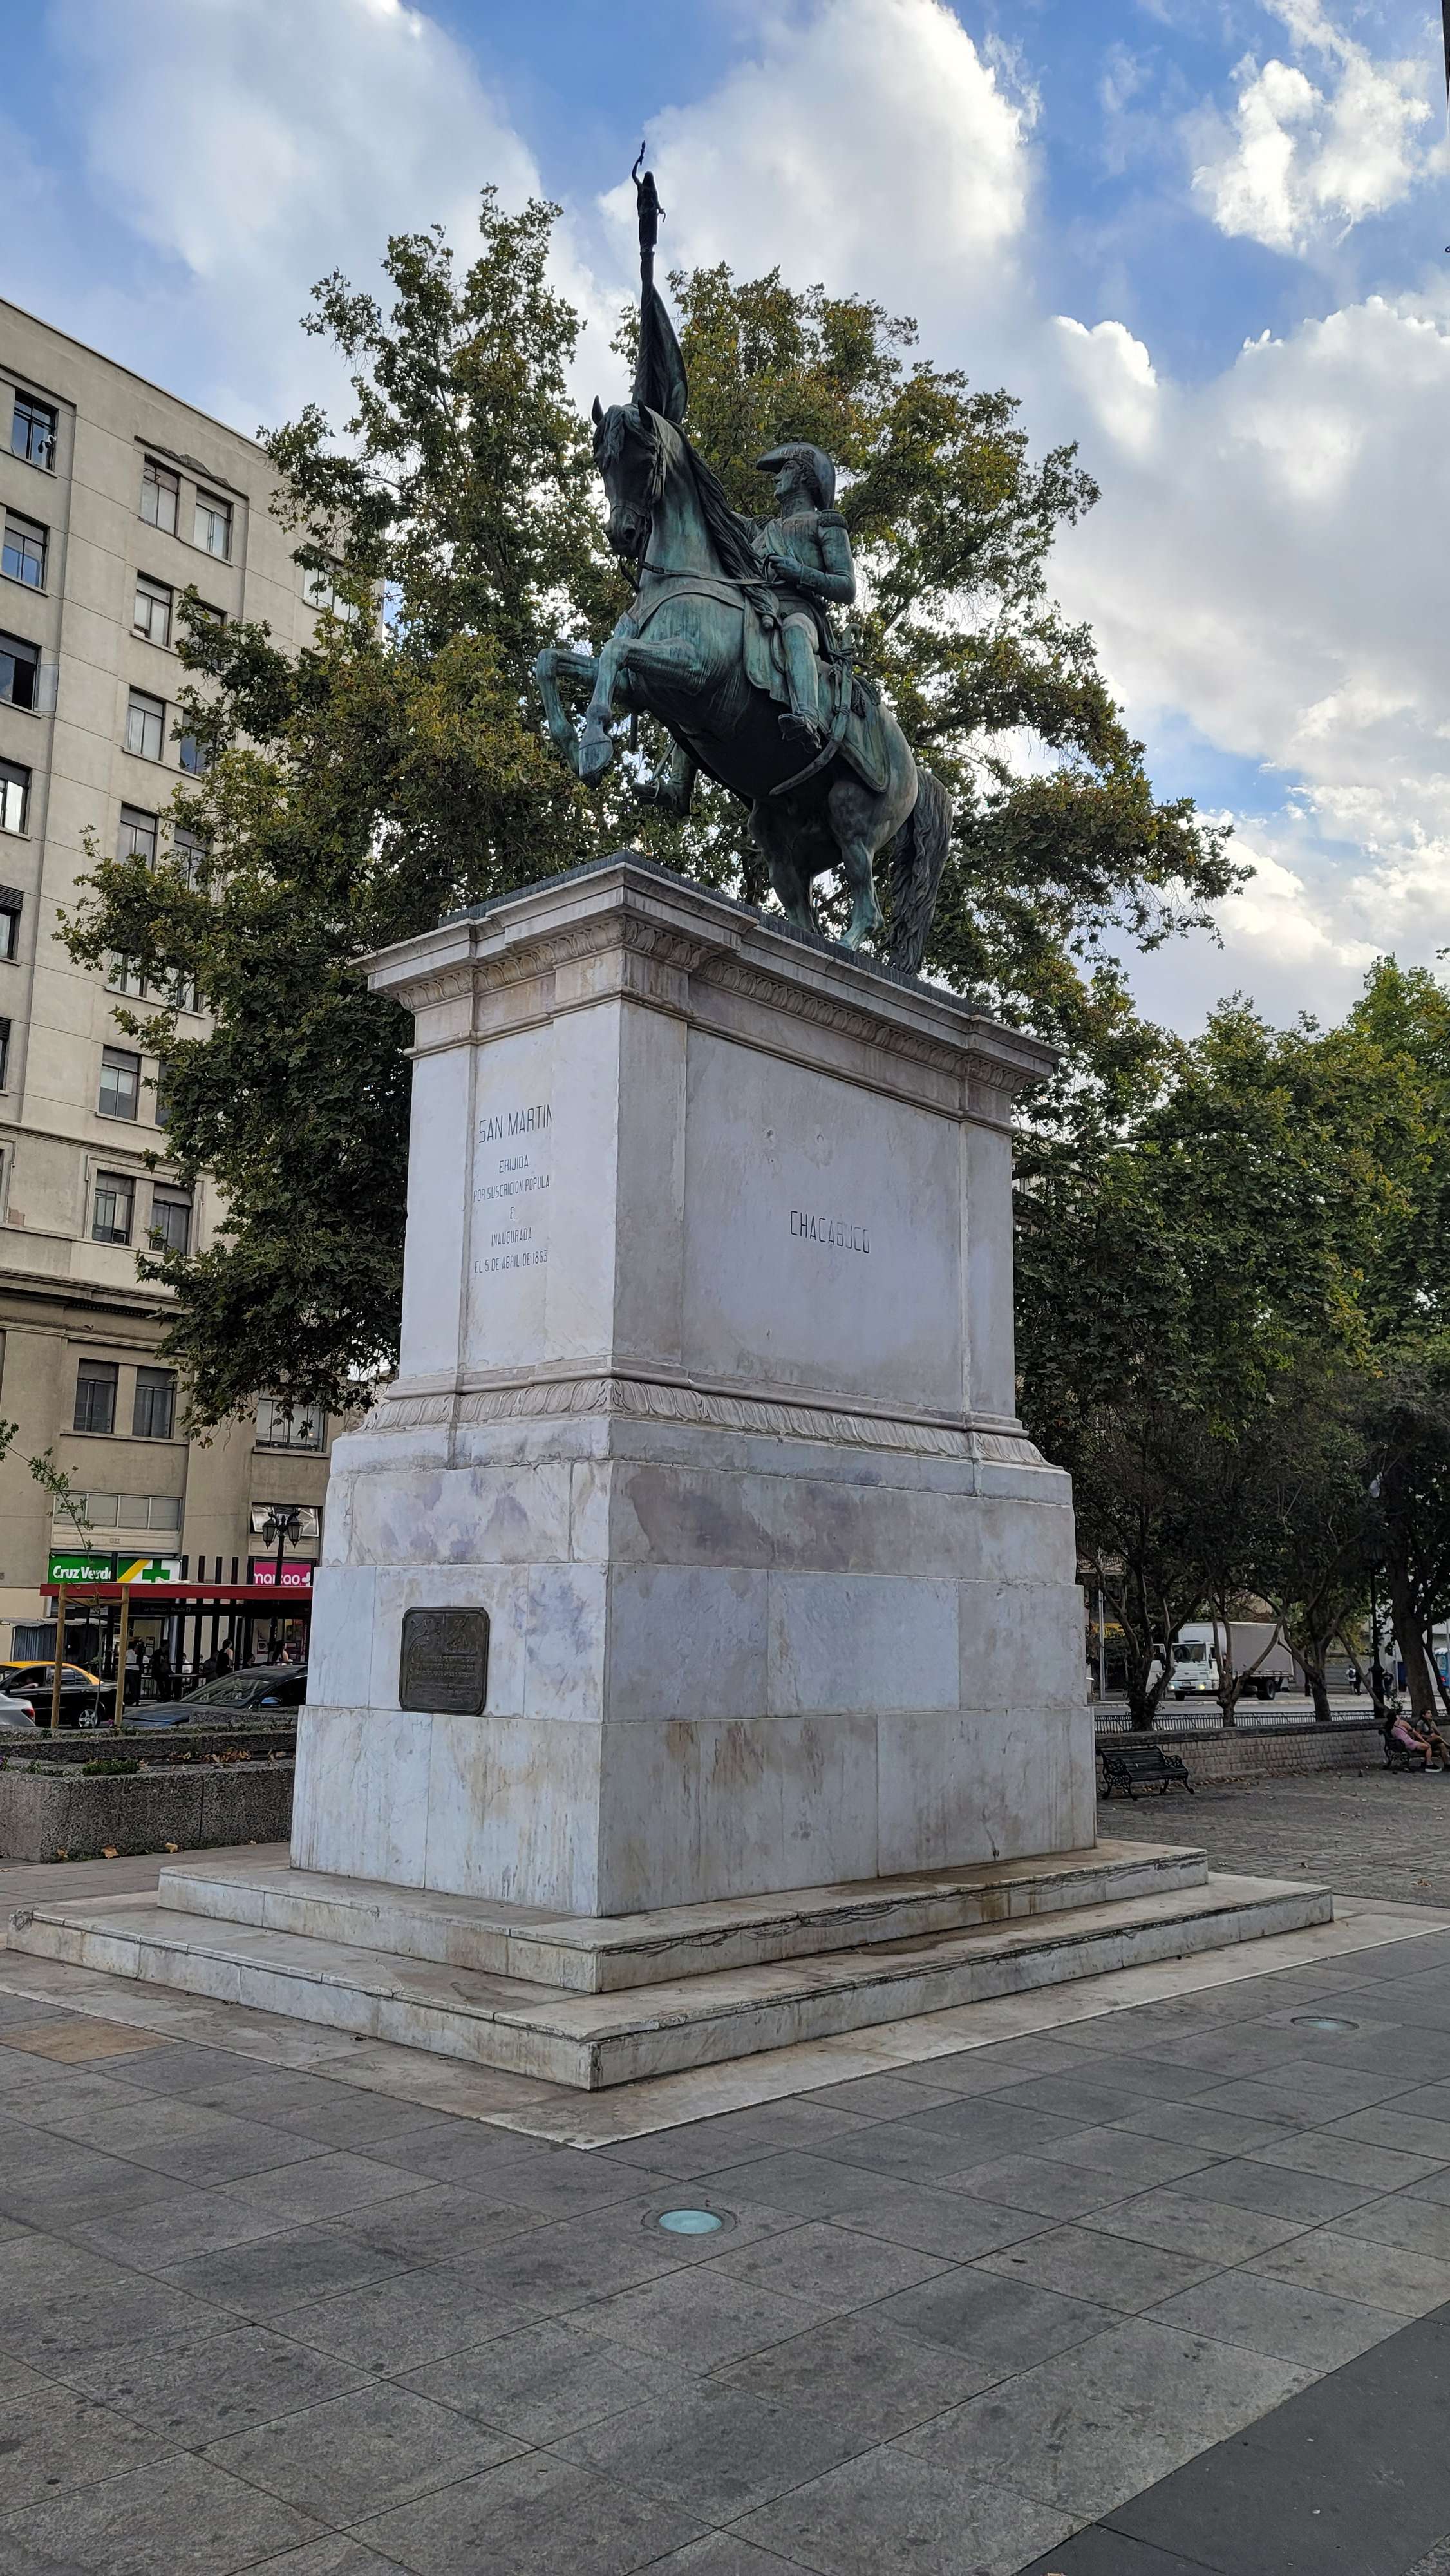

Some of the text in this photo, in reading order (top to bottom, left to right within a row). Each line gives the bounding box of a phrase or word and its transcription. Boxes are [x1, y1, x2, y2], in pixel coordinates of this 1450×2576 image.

[479, 1115, 503, 1144] SAN
[499, 1155, 529, 1173] ERIJIDA
[473, 1175, 550, 1203] POR SUSCRICION POPULA
[510, 1206, 514, 1219] E
[491, 1227, 532, 1247] INAUGURADA
[790, 1210, 870, 1253] CHACABUCO
[475, 1249, 548, 1274] EL 5 DE ABRIL DE 1863
[53, 1565, 80, 1579] Cruz
[254, 1573, 301, 1585] maiao
